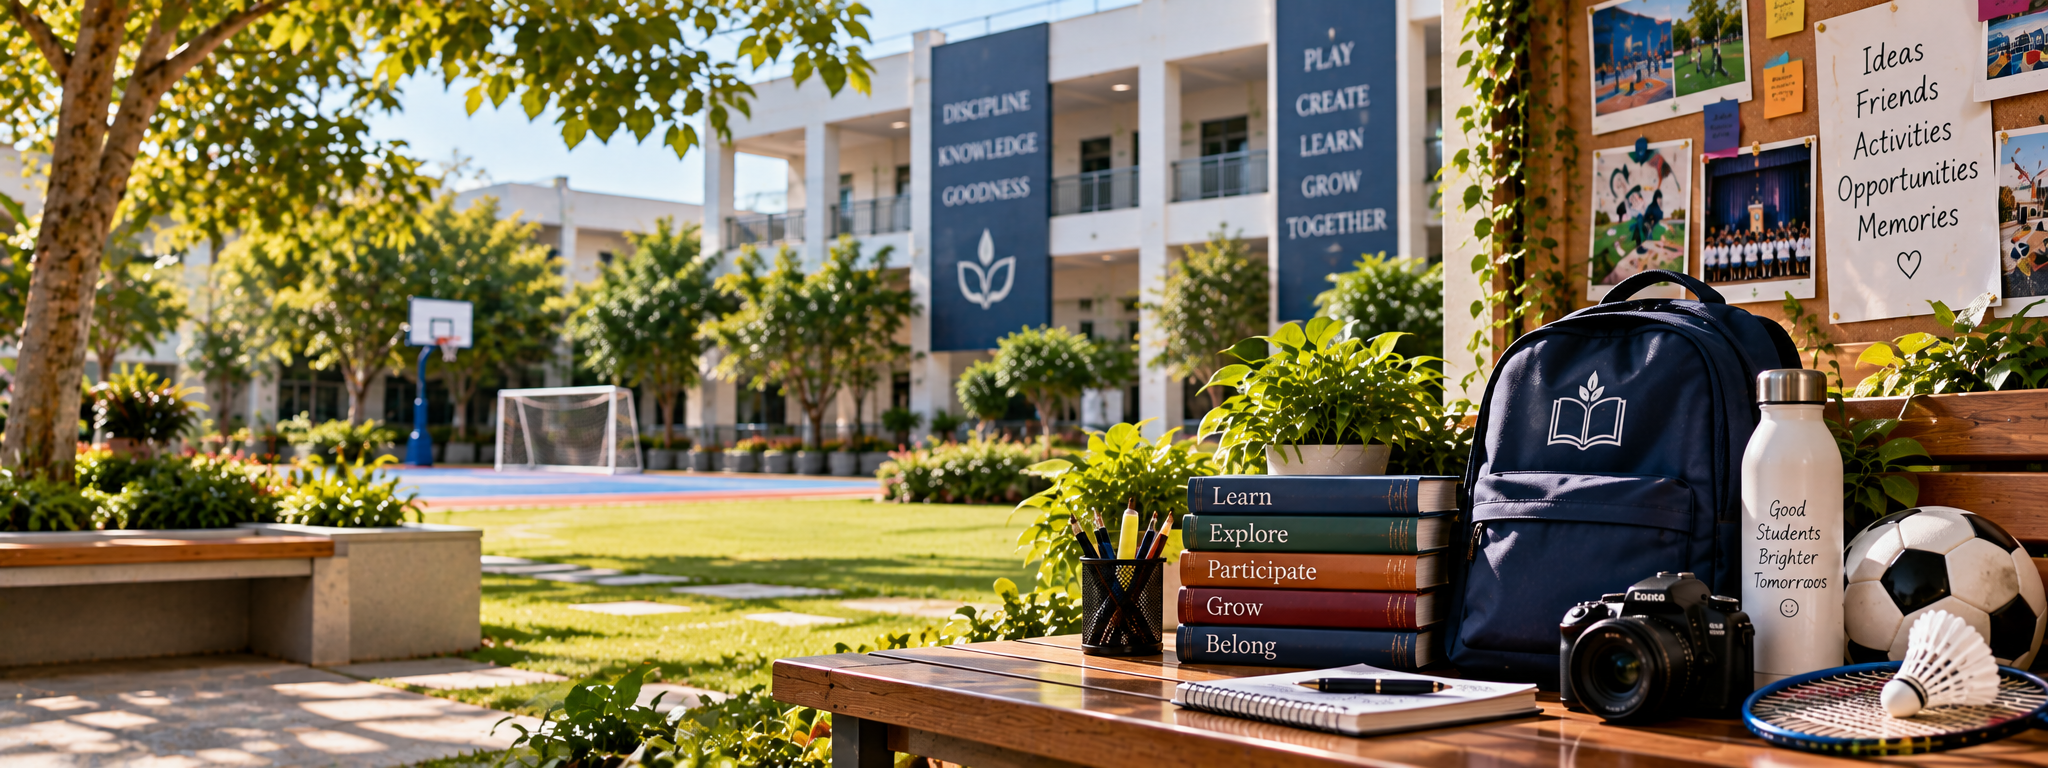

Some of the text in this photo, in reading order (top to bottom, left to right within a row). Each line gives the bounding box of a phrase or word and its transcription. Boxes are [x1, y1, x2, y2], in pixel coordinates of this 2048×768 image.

[1304, 41, 1355, 72] PLAY
[1862, 41, 1925, 76] Ideas
[943, 90, 1031, 125] DISCIPLINE
[1296, 84, 1370, 117] CREATE
[1856, 75, 1939, 119] Friends
[938, 132, 1038, 167] KNOWLEDGE
[1300, 127, 1365, 158] LEARN
[1853, 120, 1952, 161] Activities
[942, 176, 1031, 207] GOODNESS
[1301, 169, 1362, 199] GROW
[1837, 157, 1979, 209] Opportunities
[1286, 208, 1388, 240] TOGETHER
[1855, 205, 1959, 242] Memories
[1212, 486, 1273, 506] Learn
[1769, 499, 1807, 520] Good
[1209, 523, 1289, 548] Explore
[1756, 523, 1821, 541] Students
[1207, 559, 1317, 585] Participate
[1758, 547, 1819, 571] Brighter
[1206, 596, 1264, 617] Grow
[1205, 633, 1277, 660] Belong
